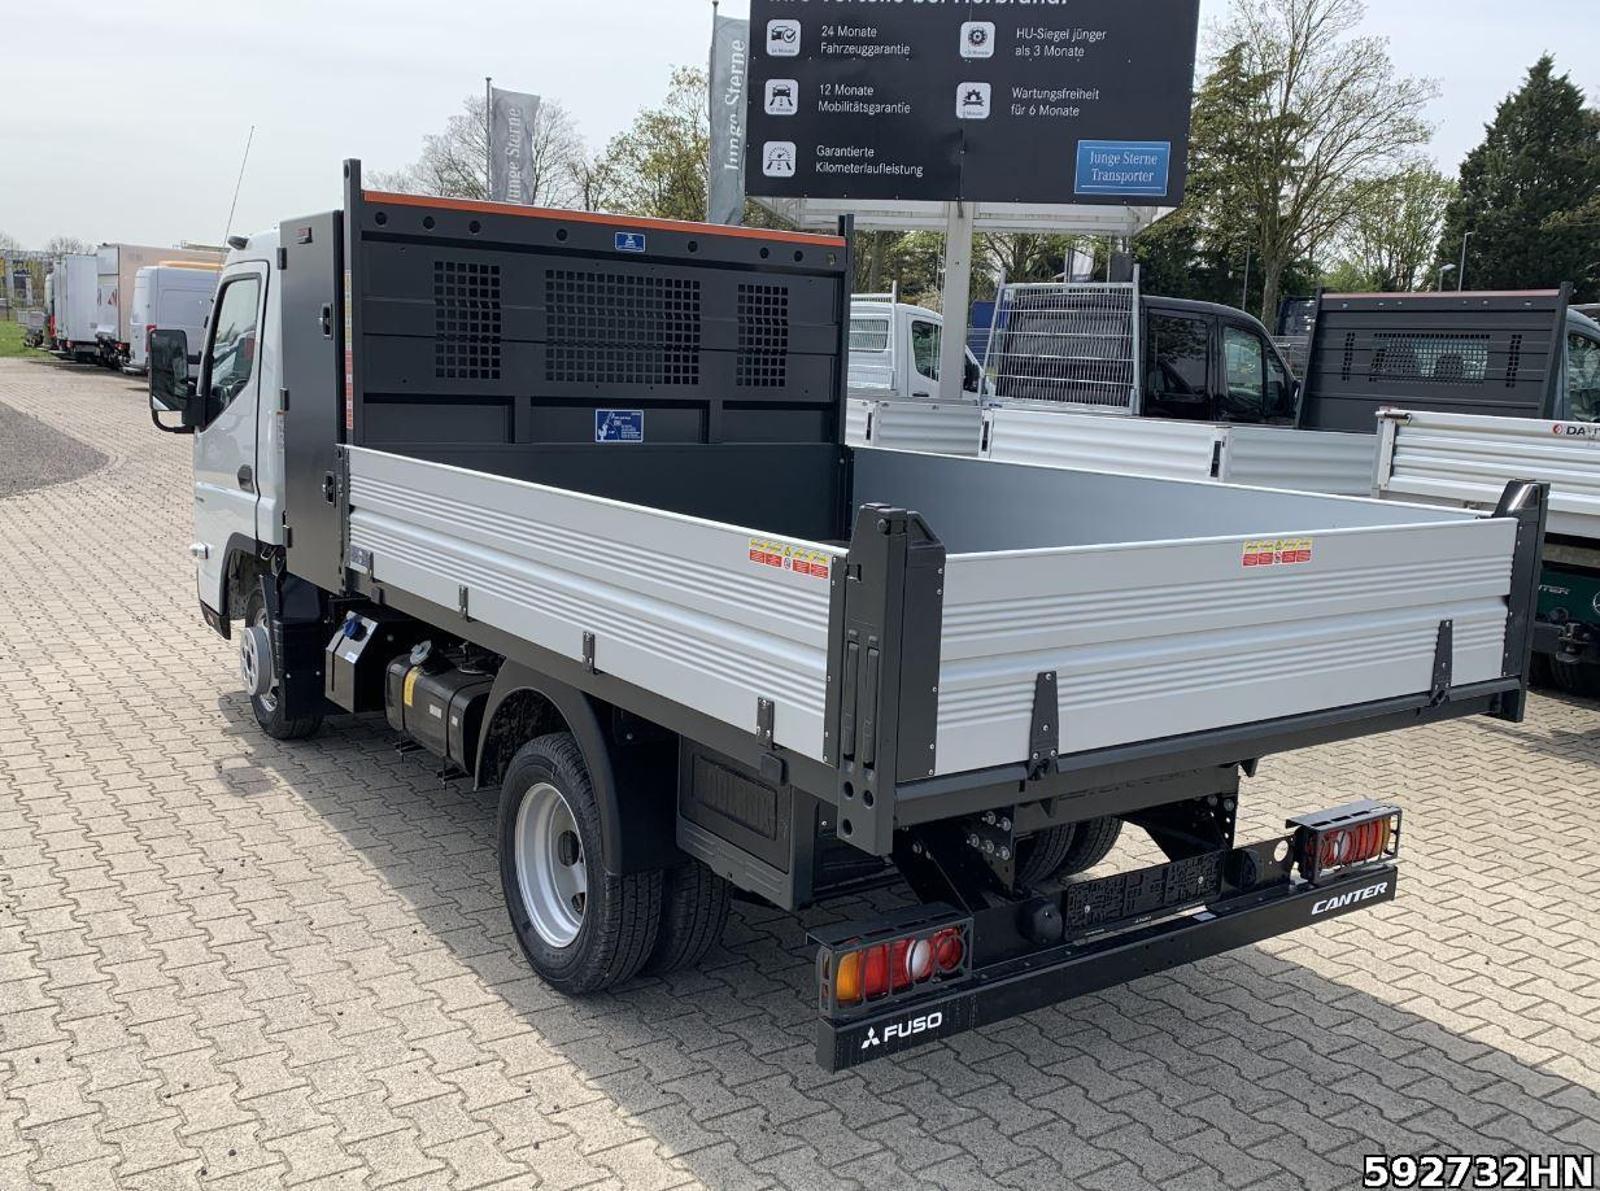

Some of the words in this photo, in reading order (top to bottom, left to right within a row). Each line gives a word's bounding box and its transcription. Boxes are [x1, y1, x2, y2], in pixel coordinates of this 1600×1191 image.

[821, 25, 834, 37] 24
[837, 26, 877, 38] Monate
[1016, 27, 1070, 42] HU-Siegel
[1072, 28, 1107, 42] jünger
[820, 42, 911, 57] Fahrzeuggarantie
[1015, 46, 1031, 56] als
[1033, 45, 1041, 56] 3
[1044, 46, 1085, 57] Monate
[724, 39, 746, 106] Sterne
[819, 84, 832, 95] 12
[835, 84, 874, 96] Monate
[1011, 87, 1100, 101] Wartungsfreiheit
[818, 100, 911, 115] Mobilitätsgarantie
[1011, 104, 1025, 115] für
[1029, 105, 1036, 115] 6
[1039, 105, 1080, 117] Monate
[505, 108, 520, 158] Sterne
[816, 144, 875, 157] Garantierte
[1089, 151, 1121, 165] Junge
[1124, 151, 1158, 165] Sterne
[815, 162, 923, 178] Kilometerlaufleistung
[1092, 168, 1154, 184] Transporter
[1311, 881, 1388, 915] CANTER
[884, 1012, 943, 1042] FUSO
